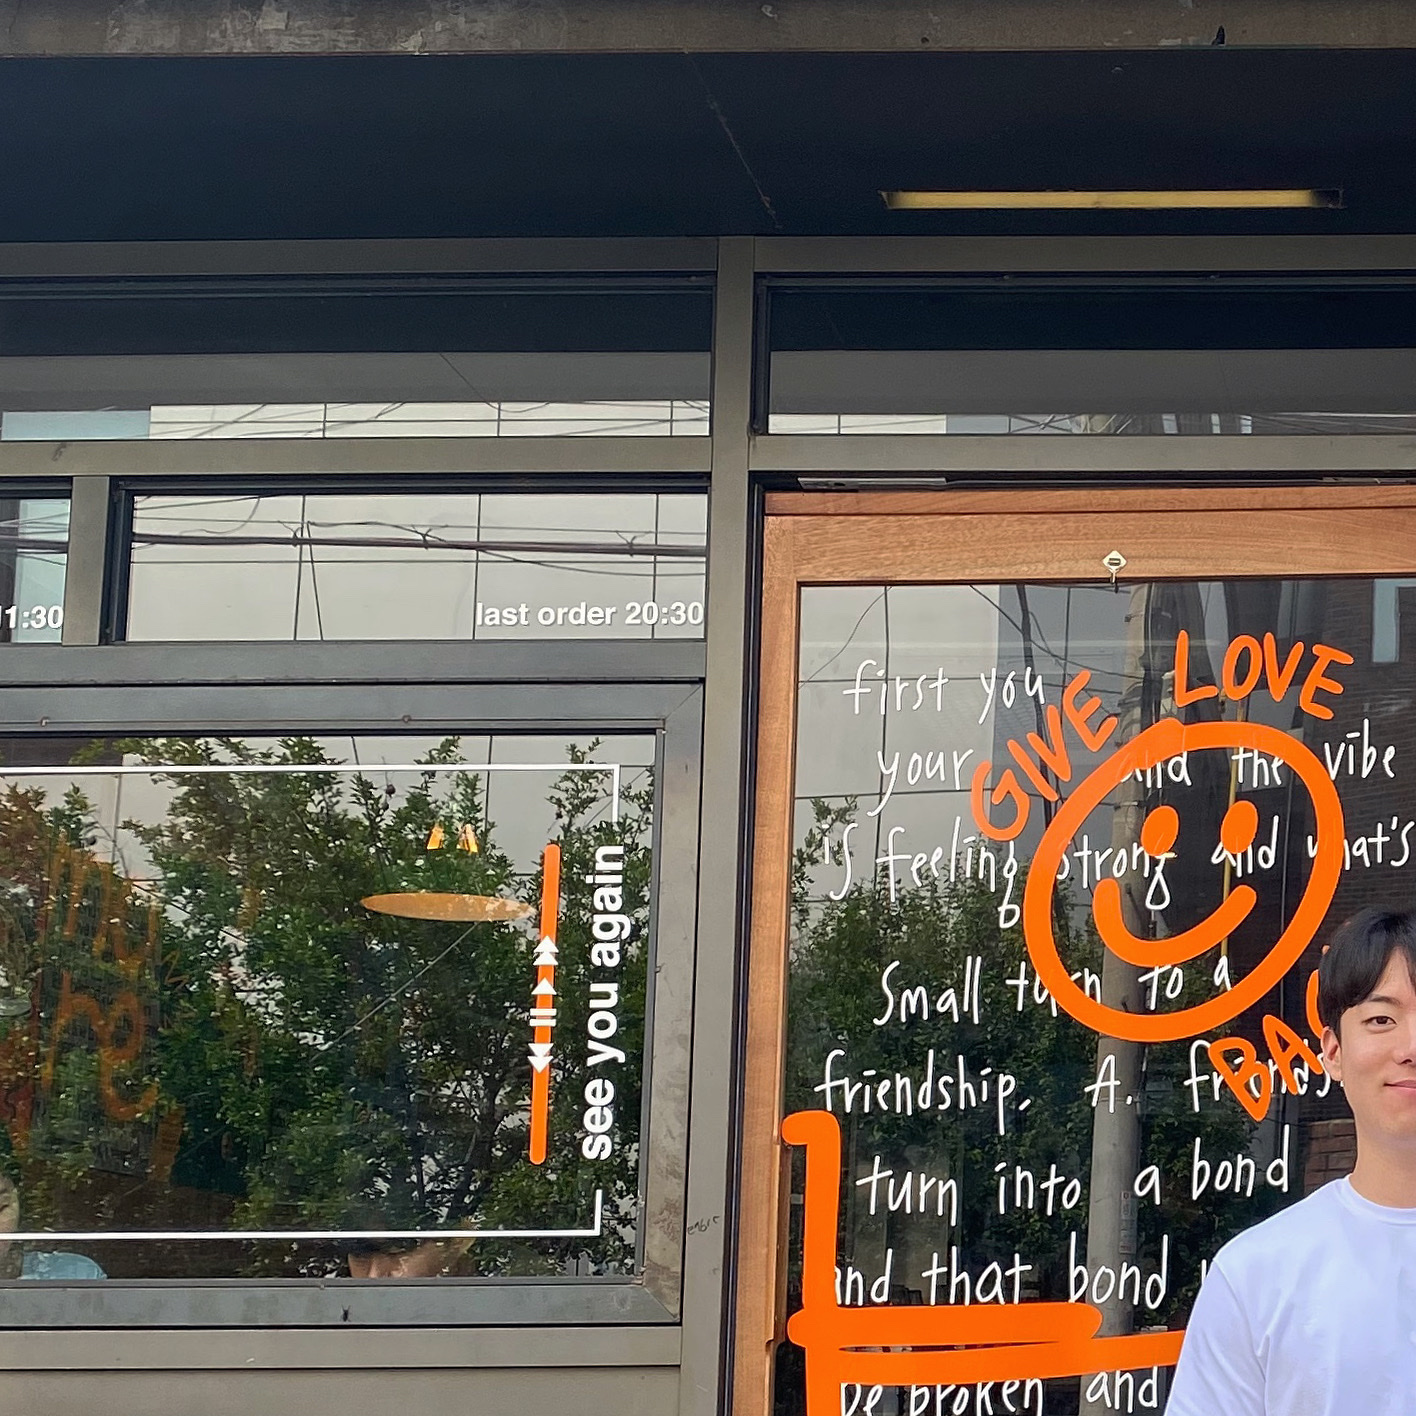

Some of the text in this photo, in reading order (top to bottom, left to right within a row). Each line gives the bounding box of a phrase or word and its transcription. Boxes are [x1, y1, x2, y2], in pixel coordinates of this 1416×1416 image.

[476, 601, 704, 626] last order 20:30
[843, 658, 1046, 726] first you
[1173, 630, 1355, 721] LOVE
[868, 747, 974, 818] your
[1231, 746, 1286, 788] the
[1324, 718, 1396, 781] vibe
[970, 670, 1119, 842] GIVE
[875, 815, 1021, 929] feeling
[1307, 816, 1416, 871] at's
[581, 844, 631, 1161] see you again
[873, 954, 1232, 1027] Small tun to a
[1208, 944, 1331, 1122] BAC
[856, 1124, 1290, 1226] turn into a bond
[921, 1245, 1033, 1306] that
[1068, 1230, 1168, 1310] bond
[1085, 1365, 1158, 1414] and
